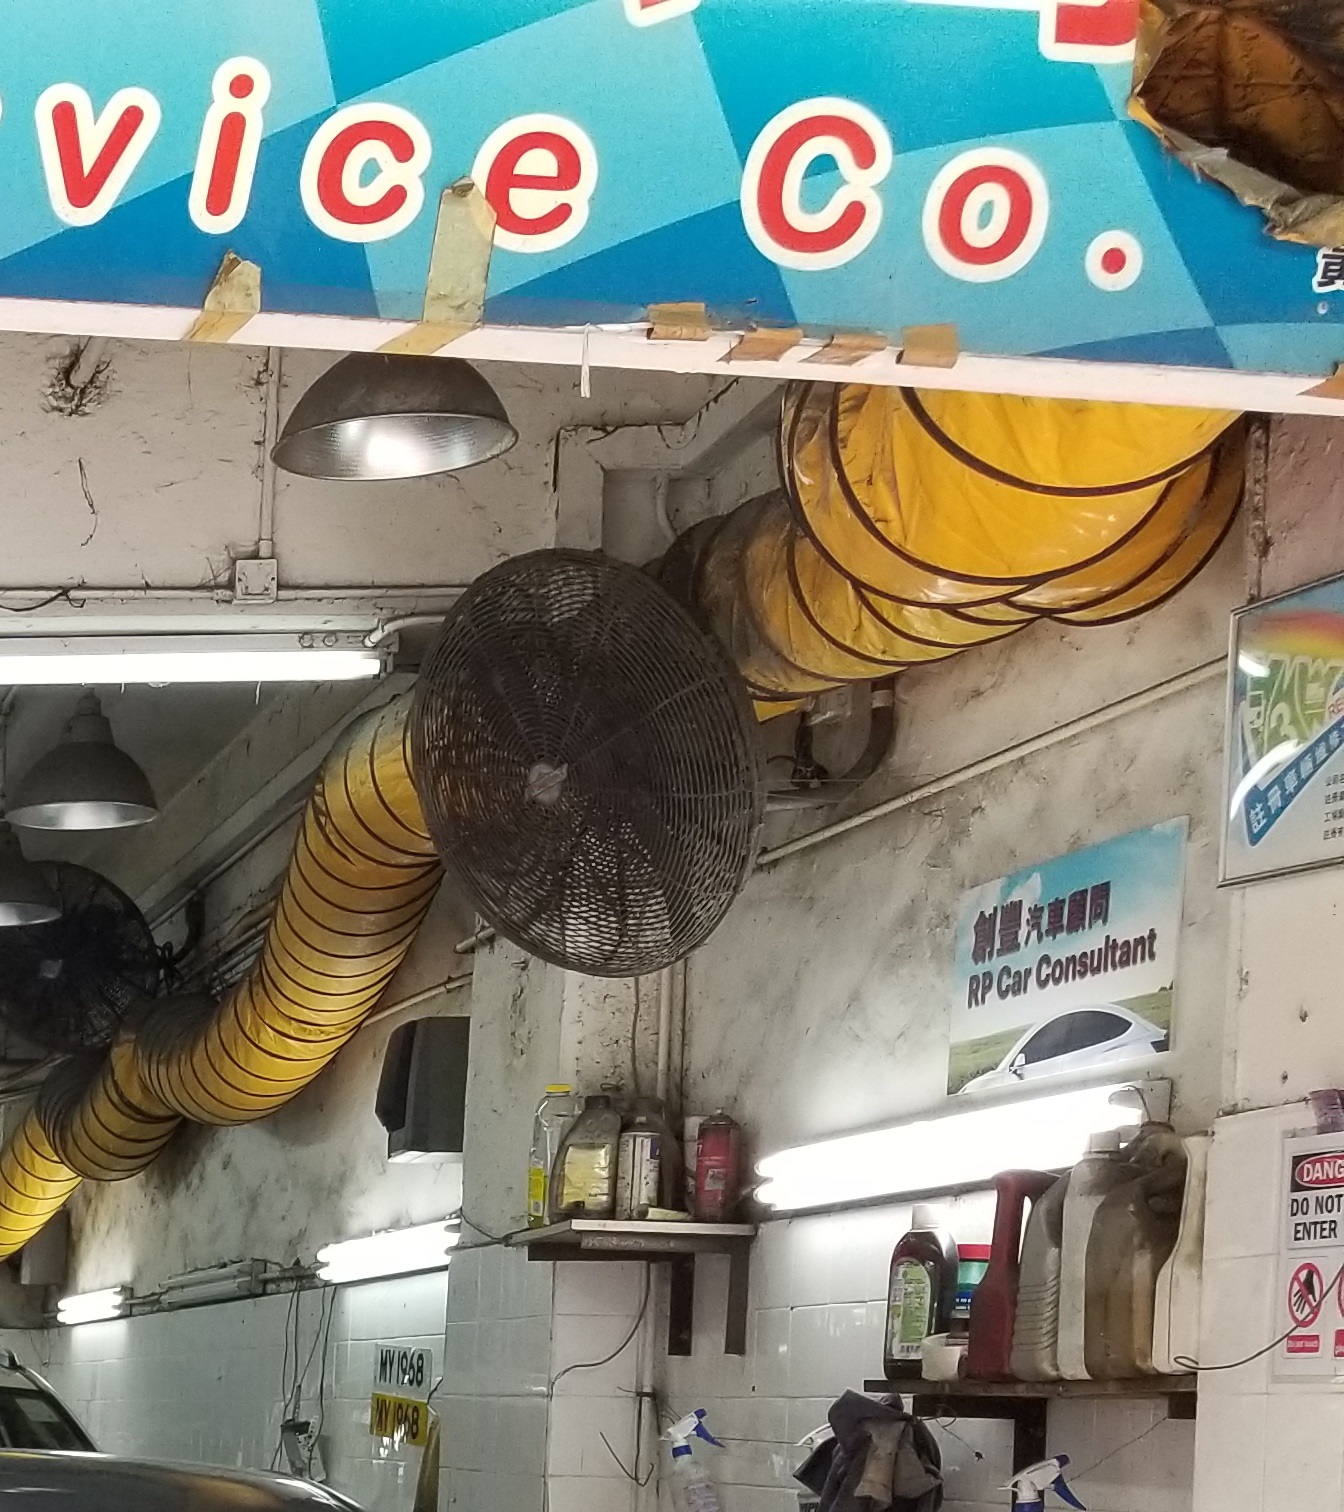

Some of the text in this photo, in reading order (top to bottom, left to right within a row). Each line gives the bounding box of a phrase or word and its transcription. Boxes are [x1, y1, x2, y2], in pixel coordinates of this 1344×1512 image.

[749, 106, 1134, 280] Co.
[967, 927, 1158, 1009] RP Car Consultant
[1290, 1194, 1344, 1217] DO NOT
[1293, 1219, 1338, 1242] ENTER
